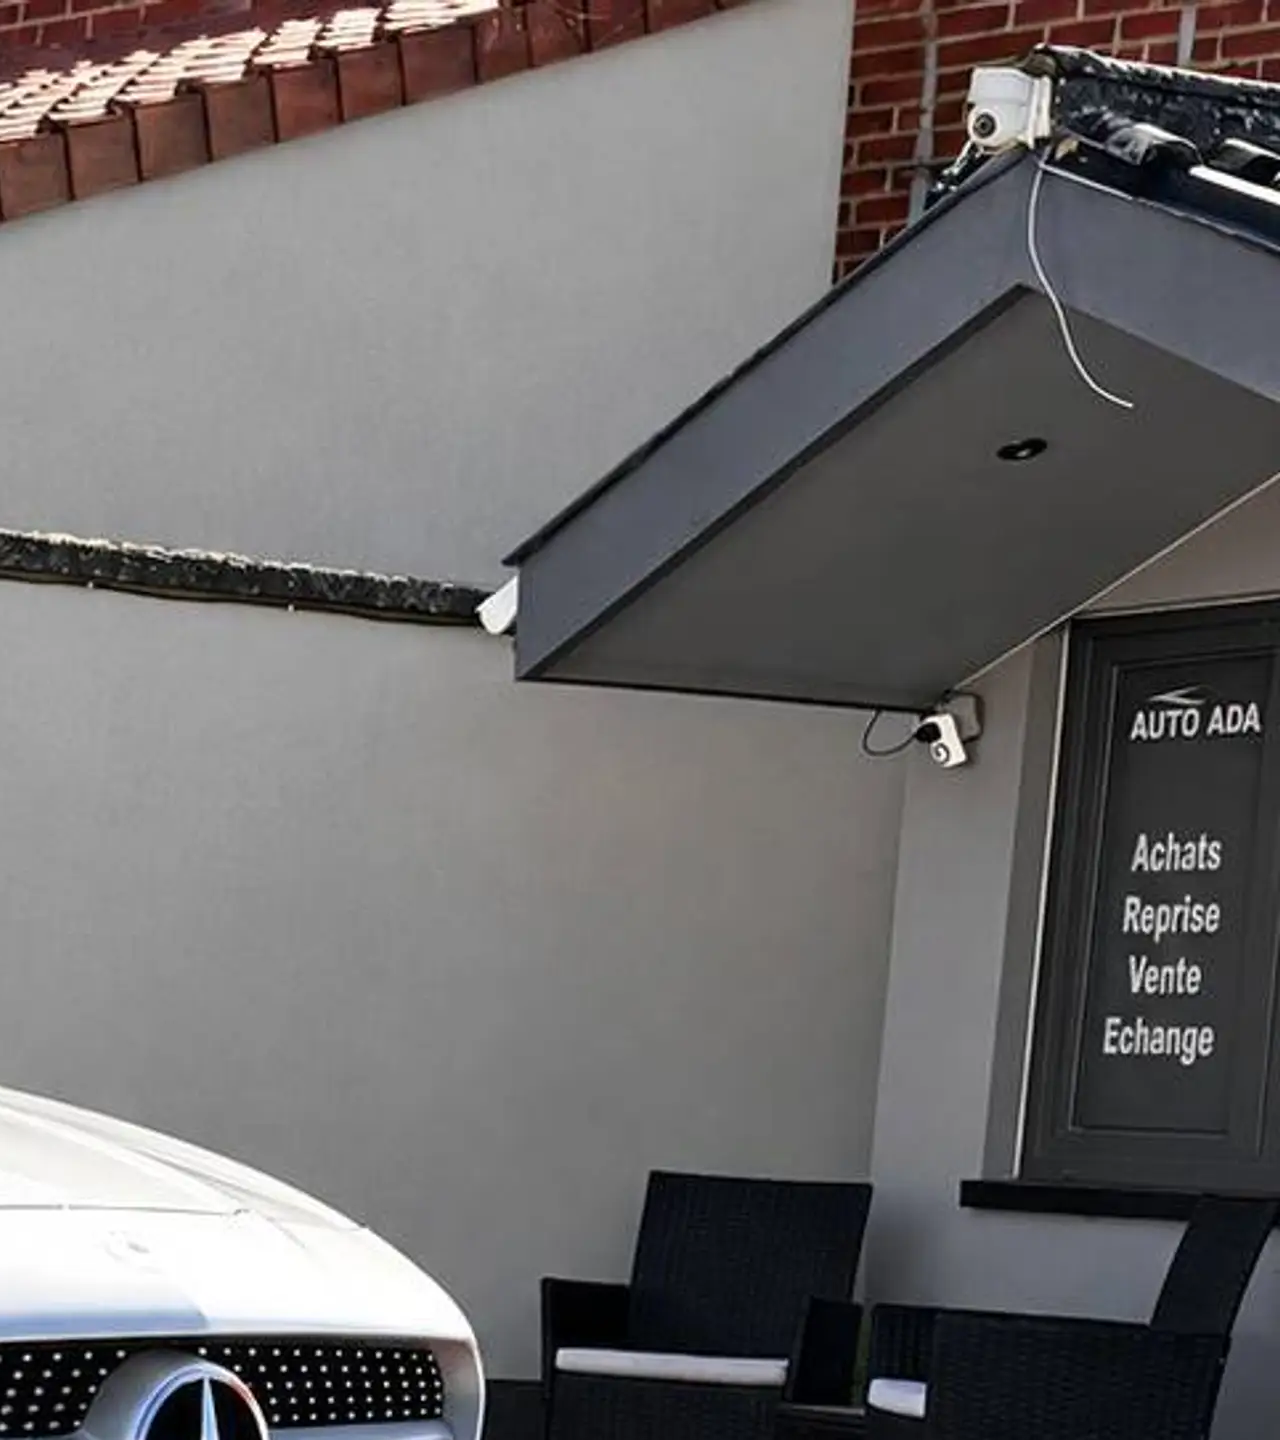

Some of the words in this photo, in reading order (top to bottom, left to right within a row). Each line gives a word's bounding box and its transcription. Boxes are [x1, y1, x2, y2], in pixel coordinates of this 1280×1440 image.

[1130, 708, 1200, 741] AUTO
[1206, 702, 1261, 736] ADA
[1131, 832, 1222, 872] Achats
[1123, 894, 1220, 943] Reprise
[1129, 955, 1202, 993] Vente
[1103, 1017, 1215, 1065] Echange
